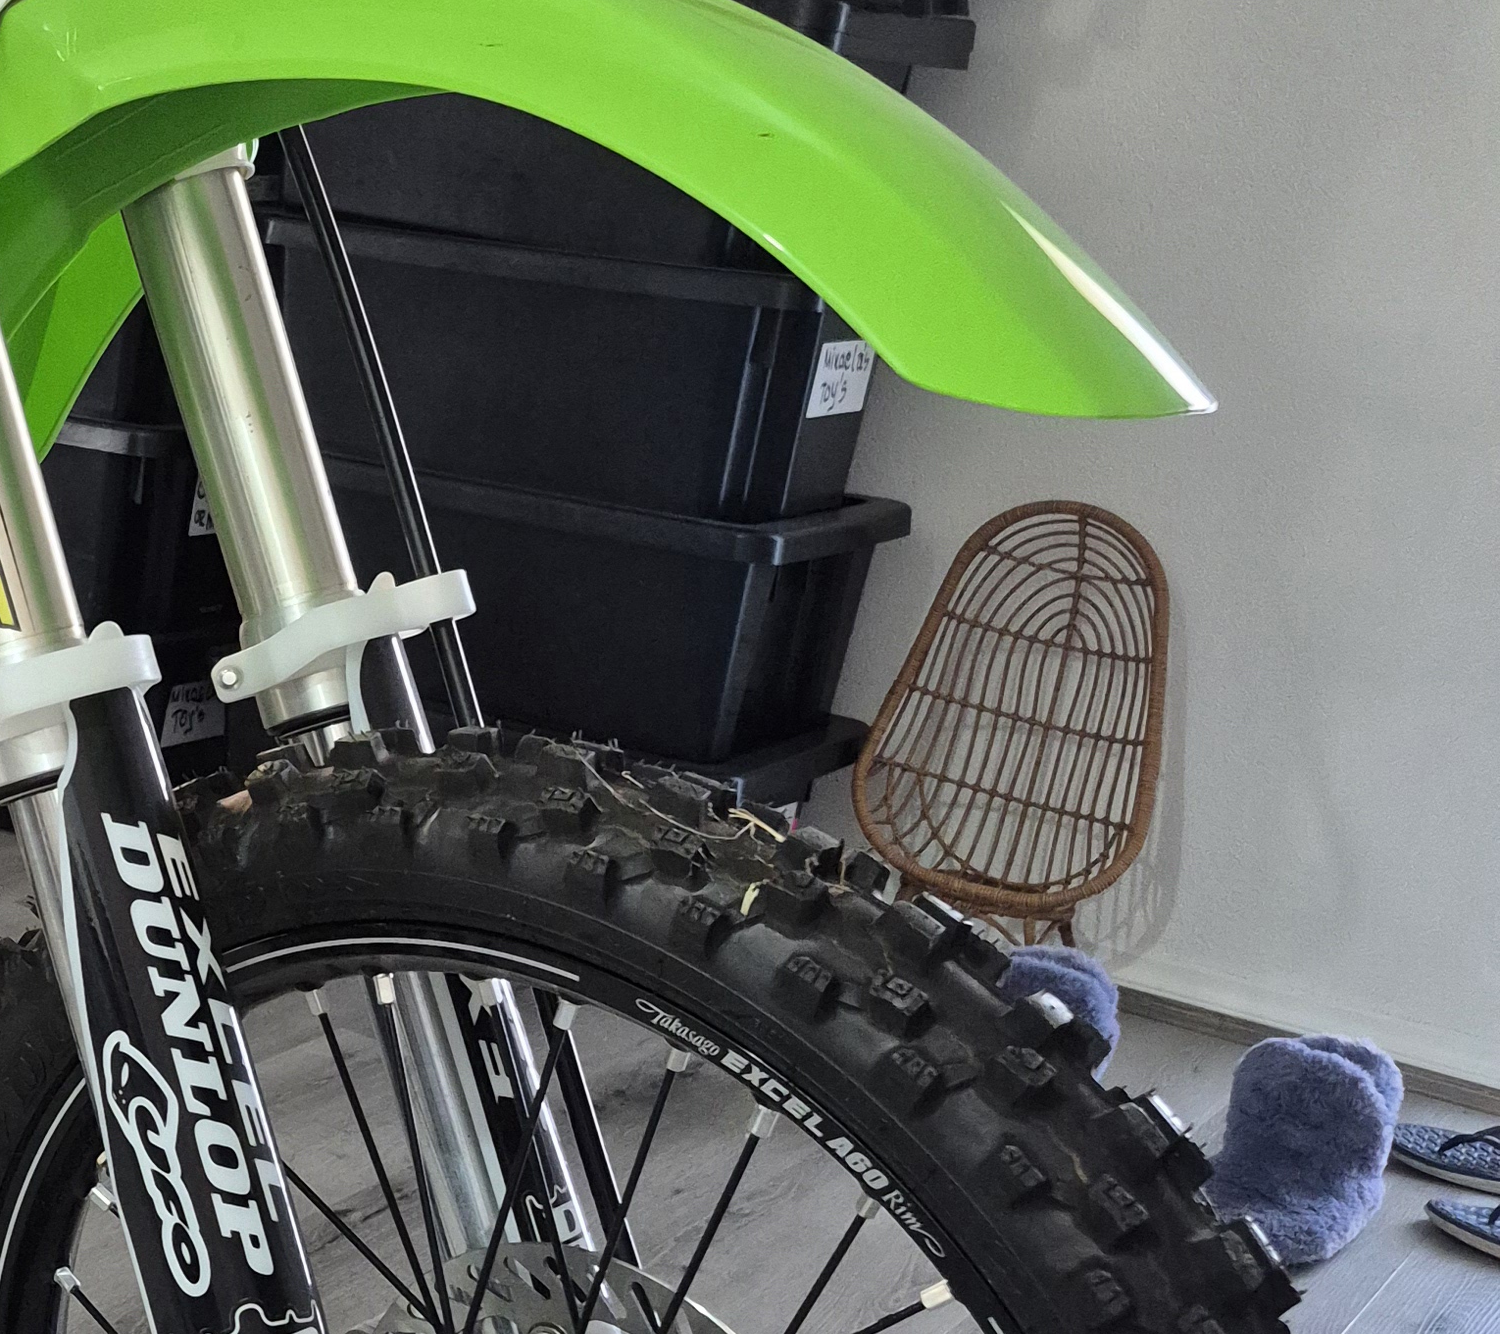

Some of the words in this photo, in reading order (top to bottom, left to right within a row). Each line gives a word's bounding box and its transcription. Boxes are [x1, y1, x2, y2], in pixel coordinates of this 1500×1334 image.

[101, 812, 275, 1277] DUNLOP
[156, 832, 281, 1222] EXCEL
[635, 998, 720, 1057] Takasago
[720, 1048, 825, 1139] EXCEL
[826, 1137, 889, 1191] A60
